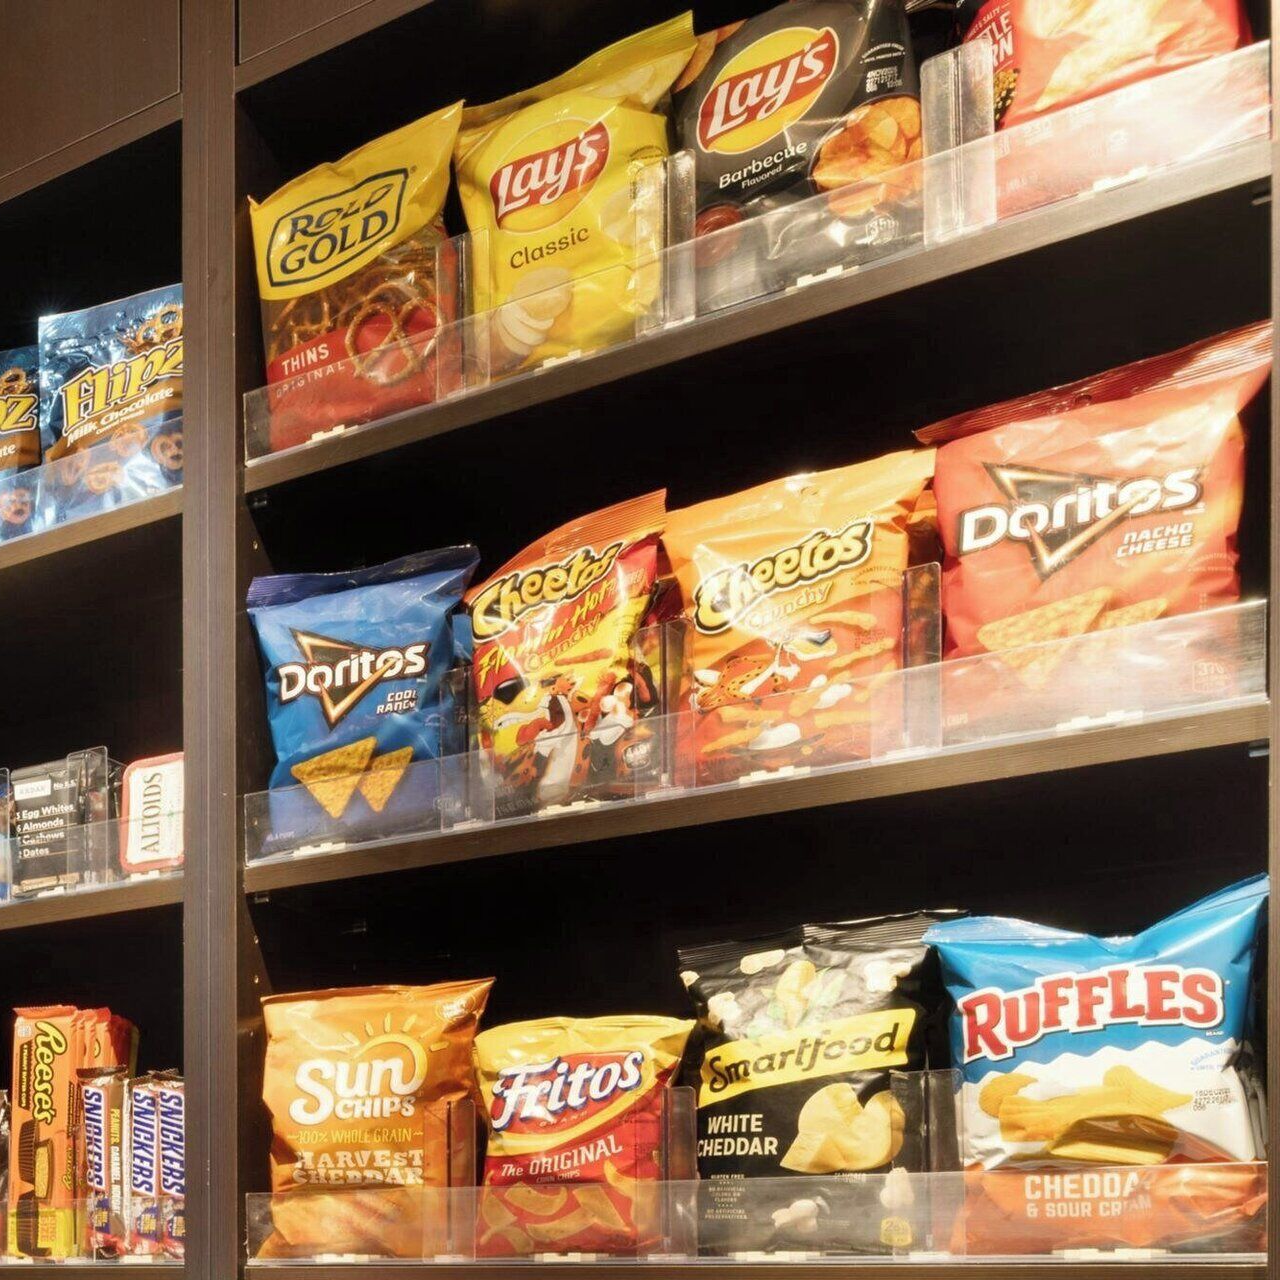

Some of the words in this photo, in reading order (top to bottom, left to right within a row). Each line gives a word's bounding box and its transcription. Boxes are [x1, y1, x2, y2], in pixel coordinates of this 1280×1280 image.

[706, 42, 829, 140] Lay's
[497, 131, 602, 218] Lay's
[718, 141, 809, 190] Barbecue
[741, 164, 783, 190] Flavored
[288, 183, 395, 245] ROLD
[280, 209, 388, 275] GOLD
[509, 226, 590, 270] Classic
[276, 361, 346, 399] ORIGINAL
[282, 343, 330, 376] THINS
[60, 336, 183, 437] Flipz
[67, 422, 98, 448] Milk
[99, 387, 174, 426] Chocolate
[959, 465, 1202, 553] Doritos
[1123, 522, 1194, 544] NACHO
[1116, 536, 1193, 559] CHEESE
[471, 541, 624, 642] Cheetos
[695, 518, 875, 636] Cheetos
[573, 583, 607, 628] Hot
[744, 581, 832, 630] Crunchy
[278, 644, 426, 701] Doritos
[22, 809, 40, 821] Egg
[41, 803, 74, 816] Whites
[23, 818, 64, 832] Almonds
[141, 772, 163, 854] ALTOIDS
[23, 847, 50, 858] Dates
[961, 968, 1220, 1059] RUFFLES
[33, 1021, 68, 1126] Reese's
[708, 1022, 901, 1093] Smartfood
[289, 1057, 423, 1126] Sun
[334, 1096, 416, 1120] CHIPS
[491, 1050, 644, 1132] Fritos
[83, 1087, 104, 1188] SNICKERS
[132, 1091, 157, 1193] SNICKERS
[159, 1091, 185, 1196] SNICKERS
[298, 1129, 328, 1145] 100%
[331, 1129, 371, 1144] WHOLE
[373, 1128, 413, 1144] GRAIN
[697, 1137, 778, 1158] CHEDDAR
[707, 1113, 764, 1135] WHITE
[292, 1167, 425, 1186] CHEDDAR
[295, 1149, 424, 1170] HARVEST
[501, 1163, 524, 1177] The
[529, 1134, 623, 1176] ORIGINAL
[557, 1169, 581, 1182] CHIPS
[1026, 1203, 1039, 1219] &
[1045, 1203, 1093, 1218] SOUR
